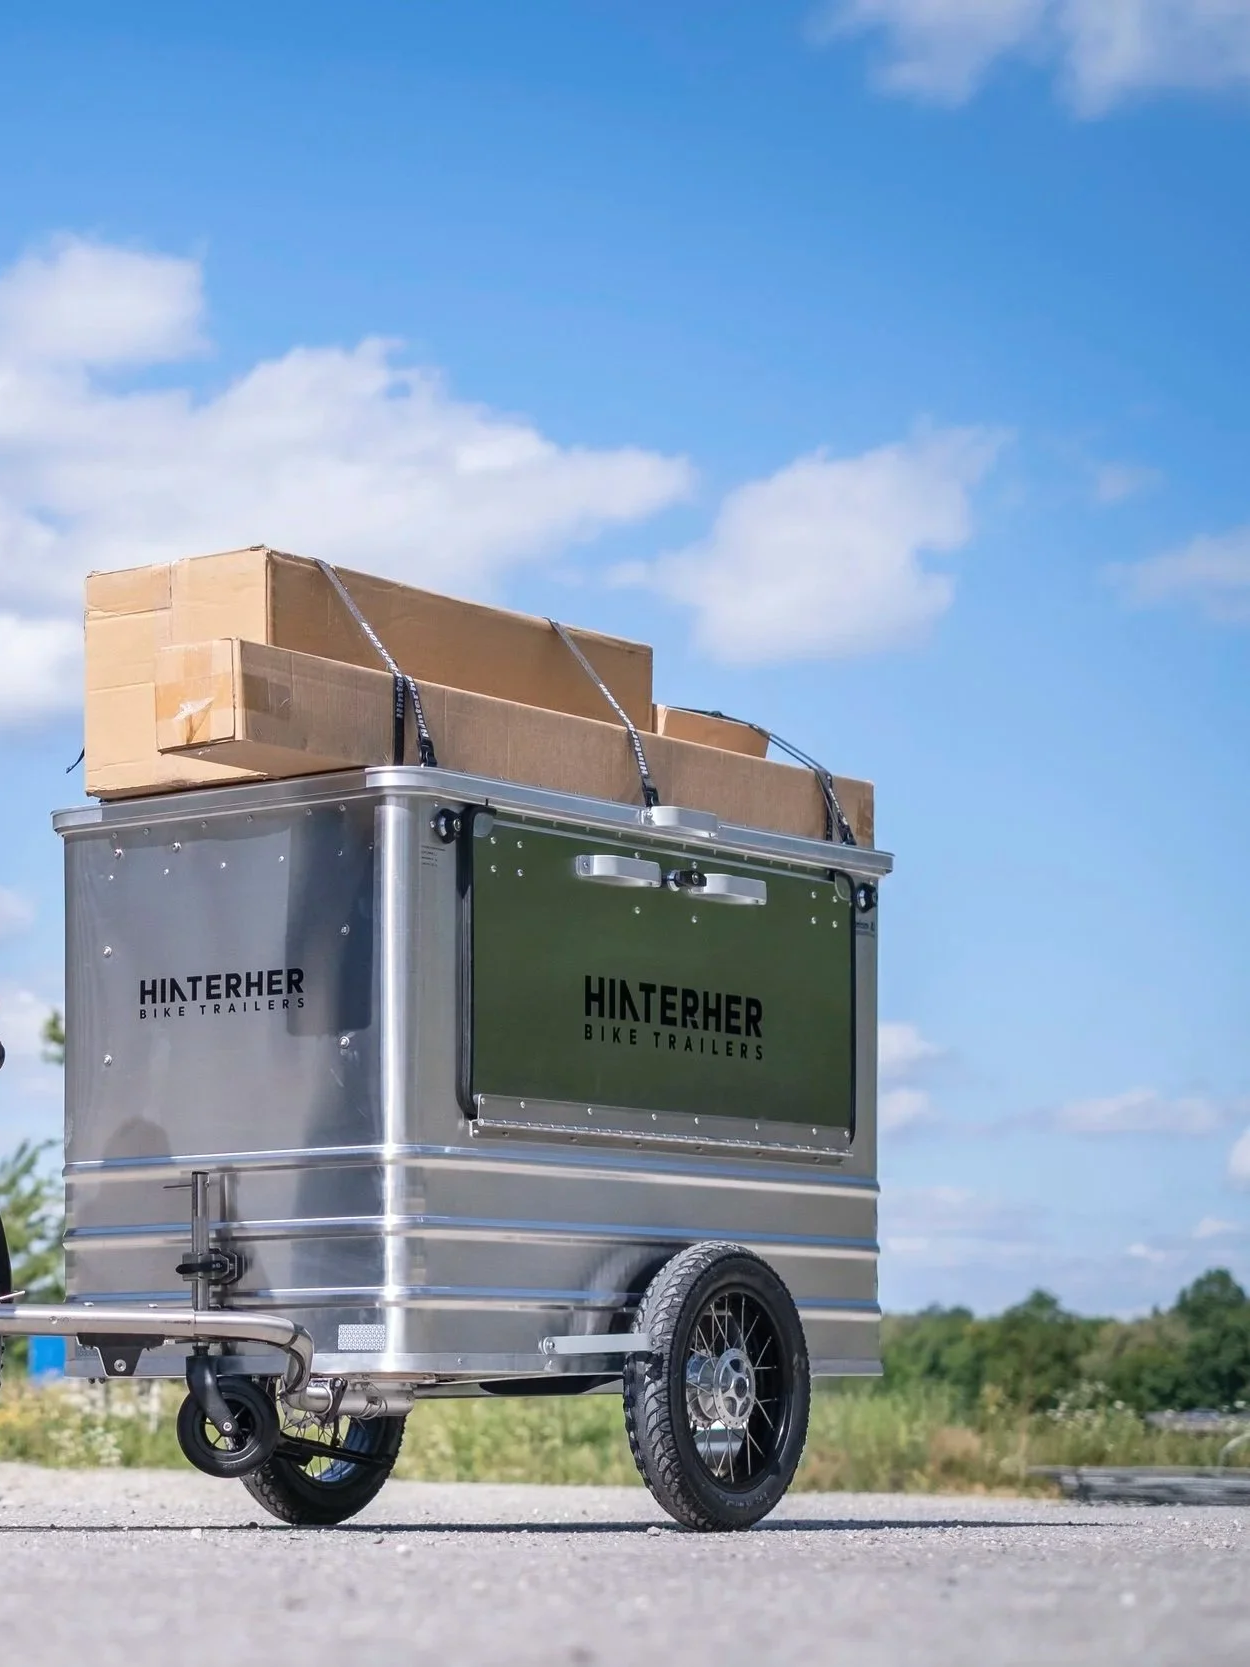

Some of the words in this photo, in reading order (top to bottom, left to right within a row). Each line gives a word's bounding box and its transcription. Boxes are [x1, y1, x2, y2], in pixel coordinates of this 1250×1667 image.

[139, 967, 305, 1005] HINTERHER
[139, 1006, 185, 1020] BIKE
[199, 997, 305, 1016] TRAILERS
[584, 975, 763, 1039] HINTERHER
[584, 1023, 637, 1046] BIKE
[653, 1031, 763, 1061] TRAILERS
